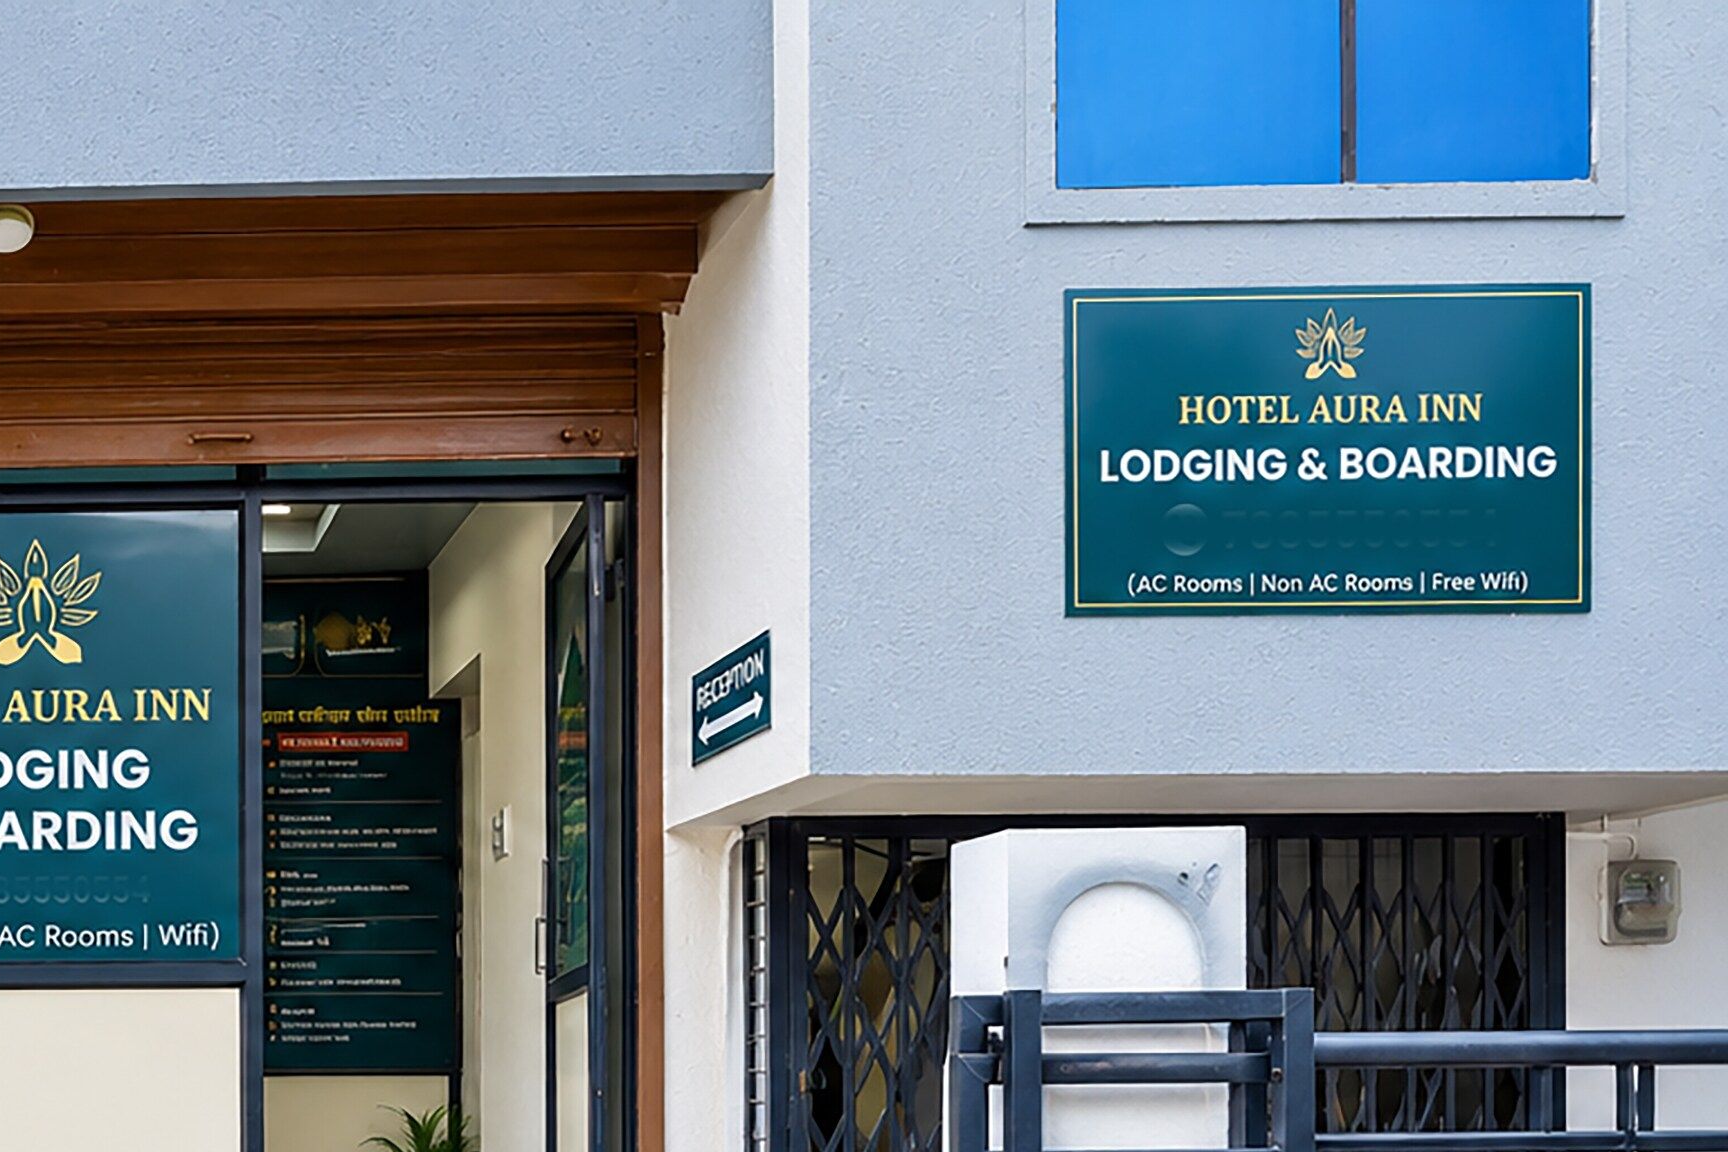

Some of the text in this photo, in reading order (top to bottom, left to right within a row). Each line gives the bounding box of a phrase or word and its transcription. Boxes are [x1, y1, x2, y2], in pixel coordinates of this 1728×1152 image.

[1178, 392, 1484, 425] HOTEL AURA INN
[1099, 444, 1559, 484] LODGING & BOARDING
[1126, 572, 1168, 598] (AC
[1172, 574, 1244, 595] Rooms
[1260, 573, 1304, 594] Non
[1307, 573, 1339, 594] AC
[1344, 572, 1415, 594] Rooms
[1431, 571, 1477, 593] Free
[695, 647, 765, 713] RECEPTION
[1, 688, 123, 724] AURA
[132, 687, 213, 723] INN
[44, 923, 135, 949] Rooms
